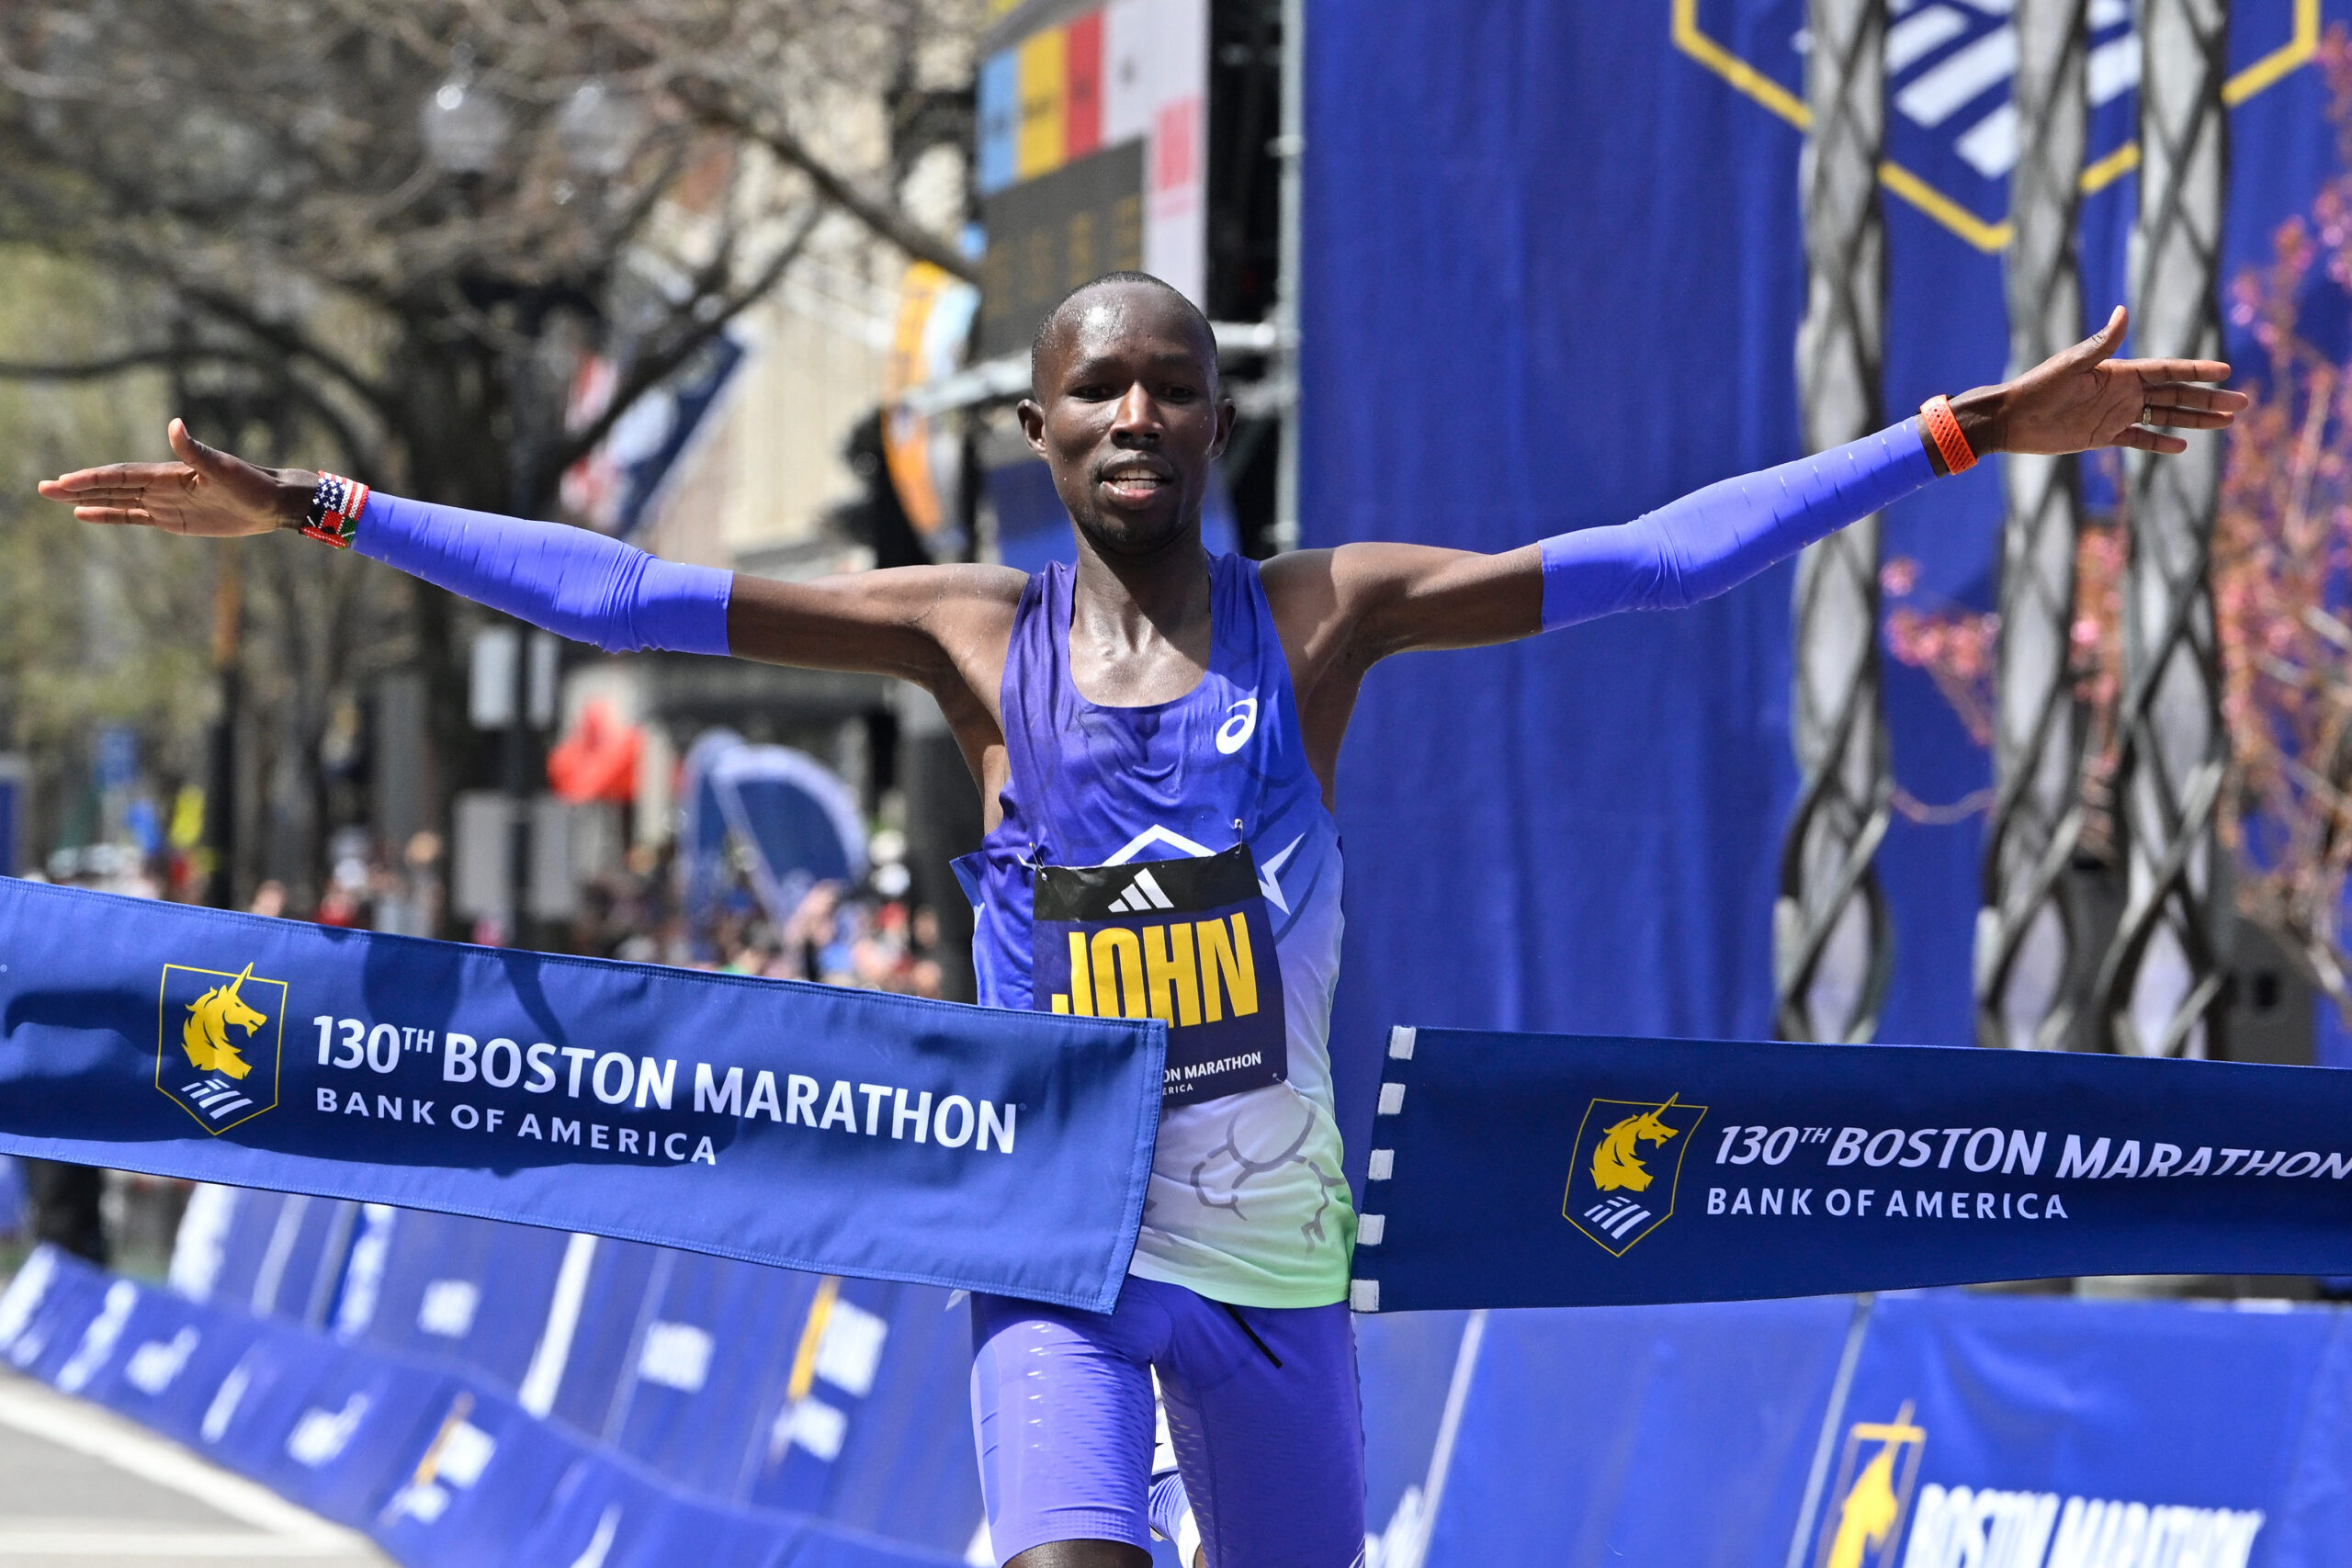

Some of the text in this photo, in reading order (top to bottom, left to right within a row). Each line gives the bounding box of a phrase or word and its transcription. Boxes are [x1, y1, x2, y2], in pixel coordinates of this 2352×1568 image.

[1051, 912, 1259, 1029] JOHN
[312, 1015, 1017, 1155] 130TH BOSTON MARATHON
[1162, 1083, 1194, 1096] ERICA
[1184, 1051, 1262, 1079] MARATHON
[315, 1087, 717, 1166] BANK OF AMERICA
[1714, 1125, 2352, 1179] 130TH BOSTON MARATHON
[1706, 1187, 2069, 1220] BANK OF AMERICA
